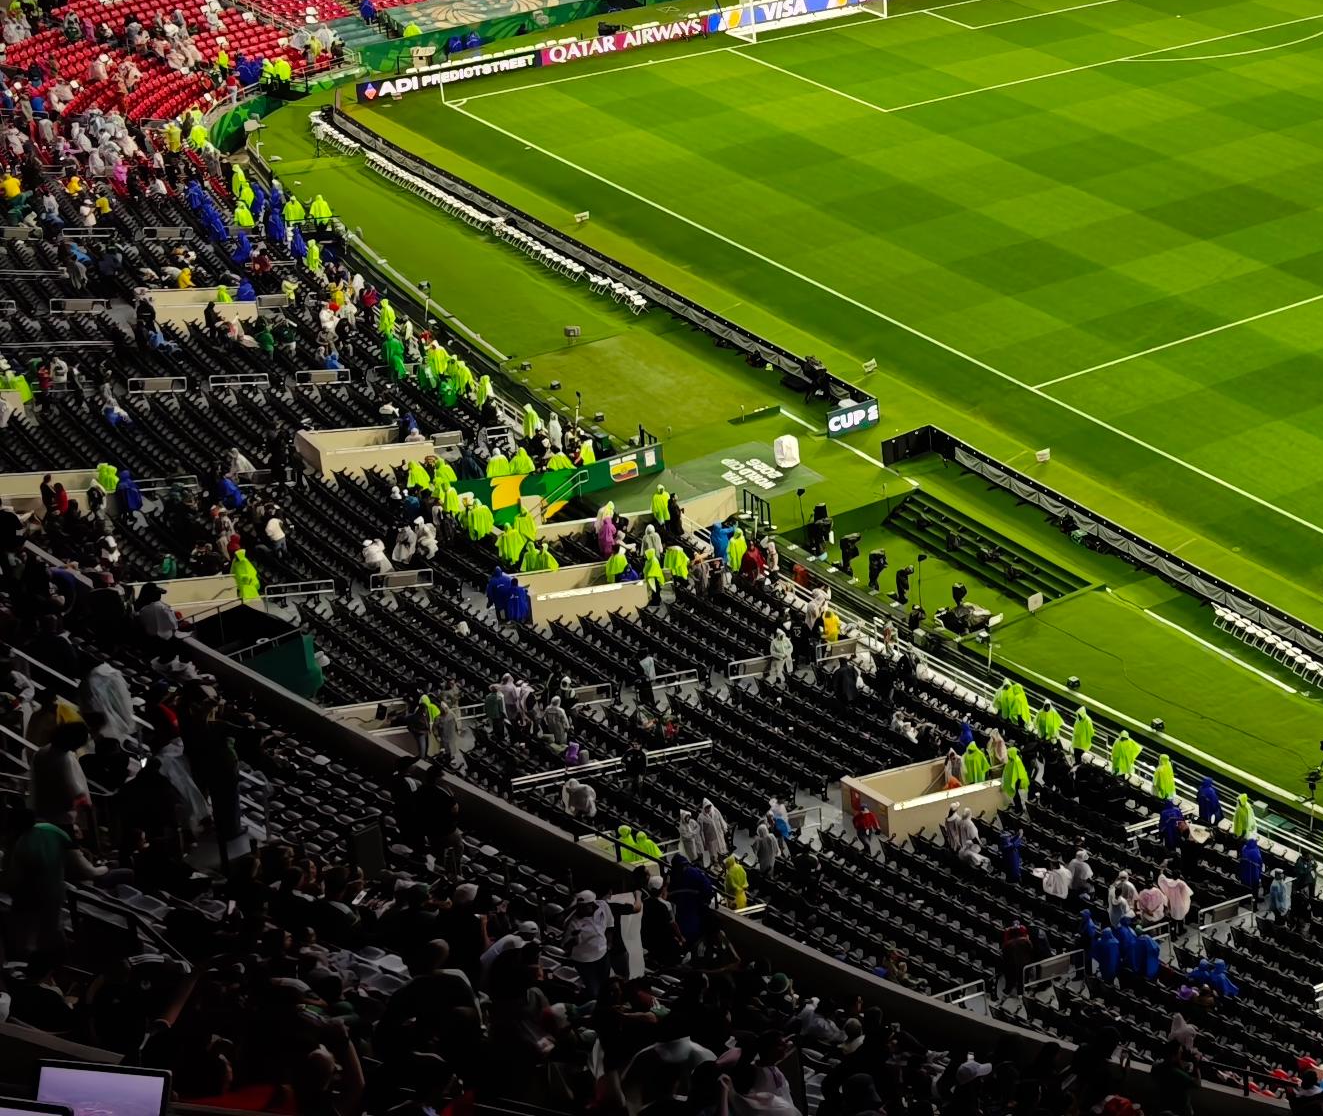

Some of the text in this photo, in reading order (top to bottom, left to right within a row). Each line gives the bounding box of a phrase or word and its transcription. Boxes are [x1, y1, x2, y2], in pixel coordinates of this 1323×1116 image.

[549, 18, 701, 63] QATAR AIRWAYS
[379, 75, 419, 97] ADI
[828, 409, 866, 432] CUP
